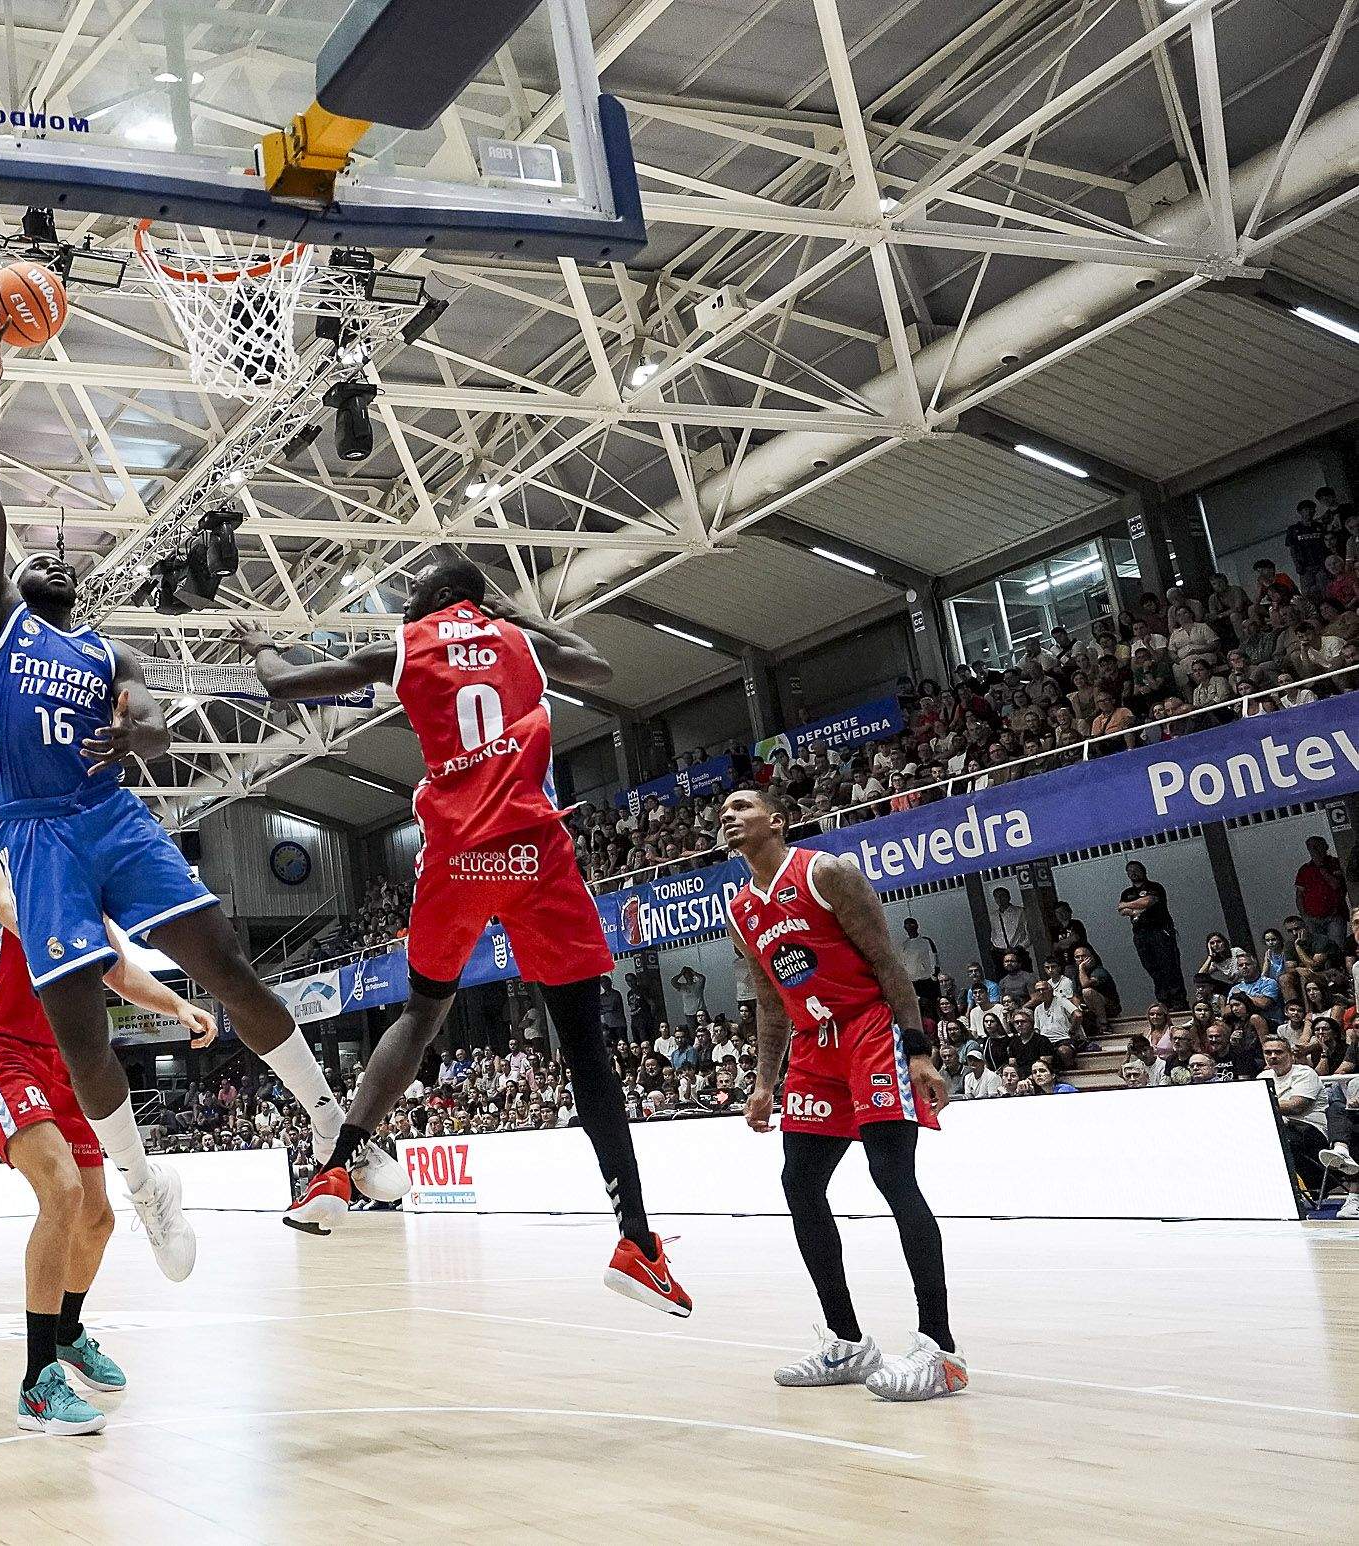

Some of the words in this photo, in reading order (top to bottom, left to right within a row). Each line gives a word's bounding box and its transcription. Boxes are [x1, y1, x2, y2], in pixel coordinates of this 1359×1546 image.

[28, 268, 59, 323] Wilson
[447, 643, 497, 667] Río
[10, 652, 108, 700] Emirates
[20, 676, 45, 695] FLY
[47, 683, 96, 709] BETTER
[34, 706, 76, 746] 16
[456, 683, 504, 752] 0
[796, 716, 859, 745] DEPORTE
[443, 737, 522, 776] ABANCA
[462, 858, 506, 873] LUGO
[653, 876, 704, 901] TORNEO
[640, 893, 727, 945] ENCESTA
[773, 949, 806, 971] Estrella
[778, 960, 809, 980] Galicia
[118, 1013, 161, 1023] DEPORTE
[805, 995, 833, 1021] 4
[118, 1020, 181, 1030] PONTEVEDRA
[786, 1092, 832, 1118] Río
[406, 1144, 473, 1186] FROIZ
